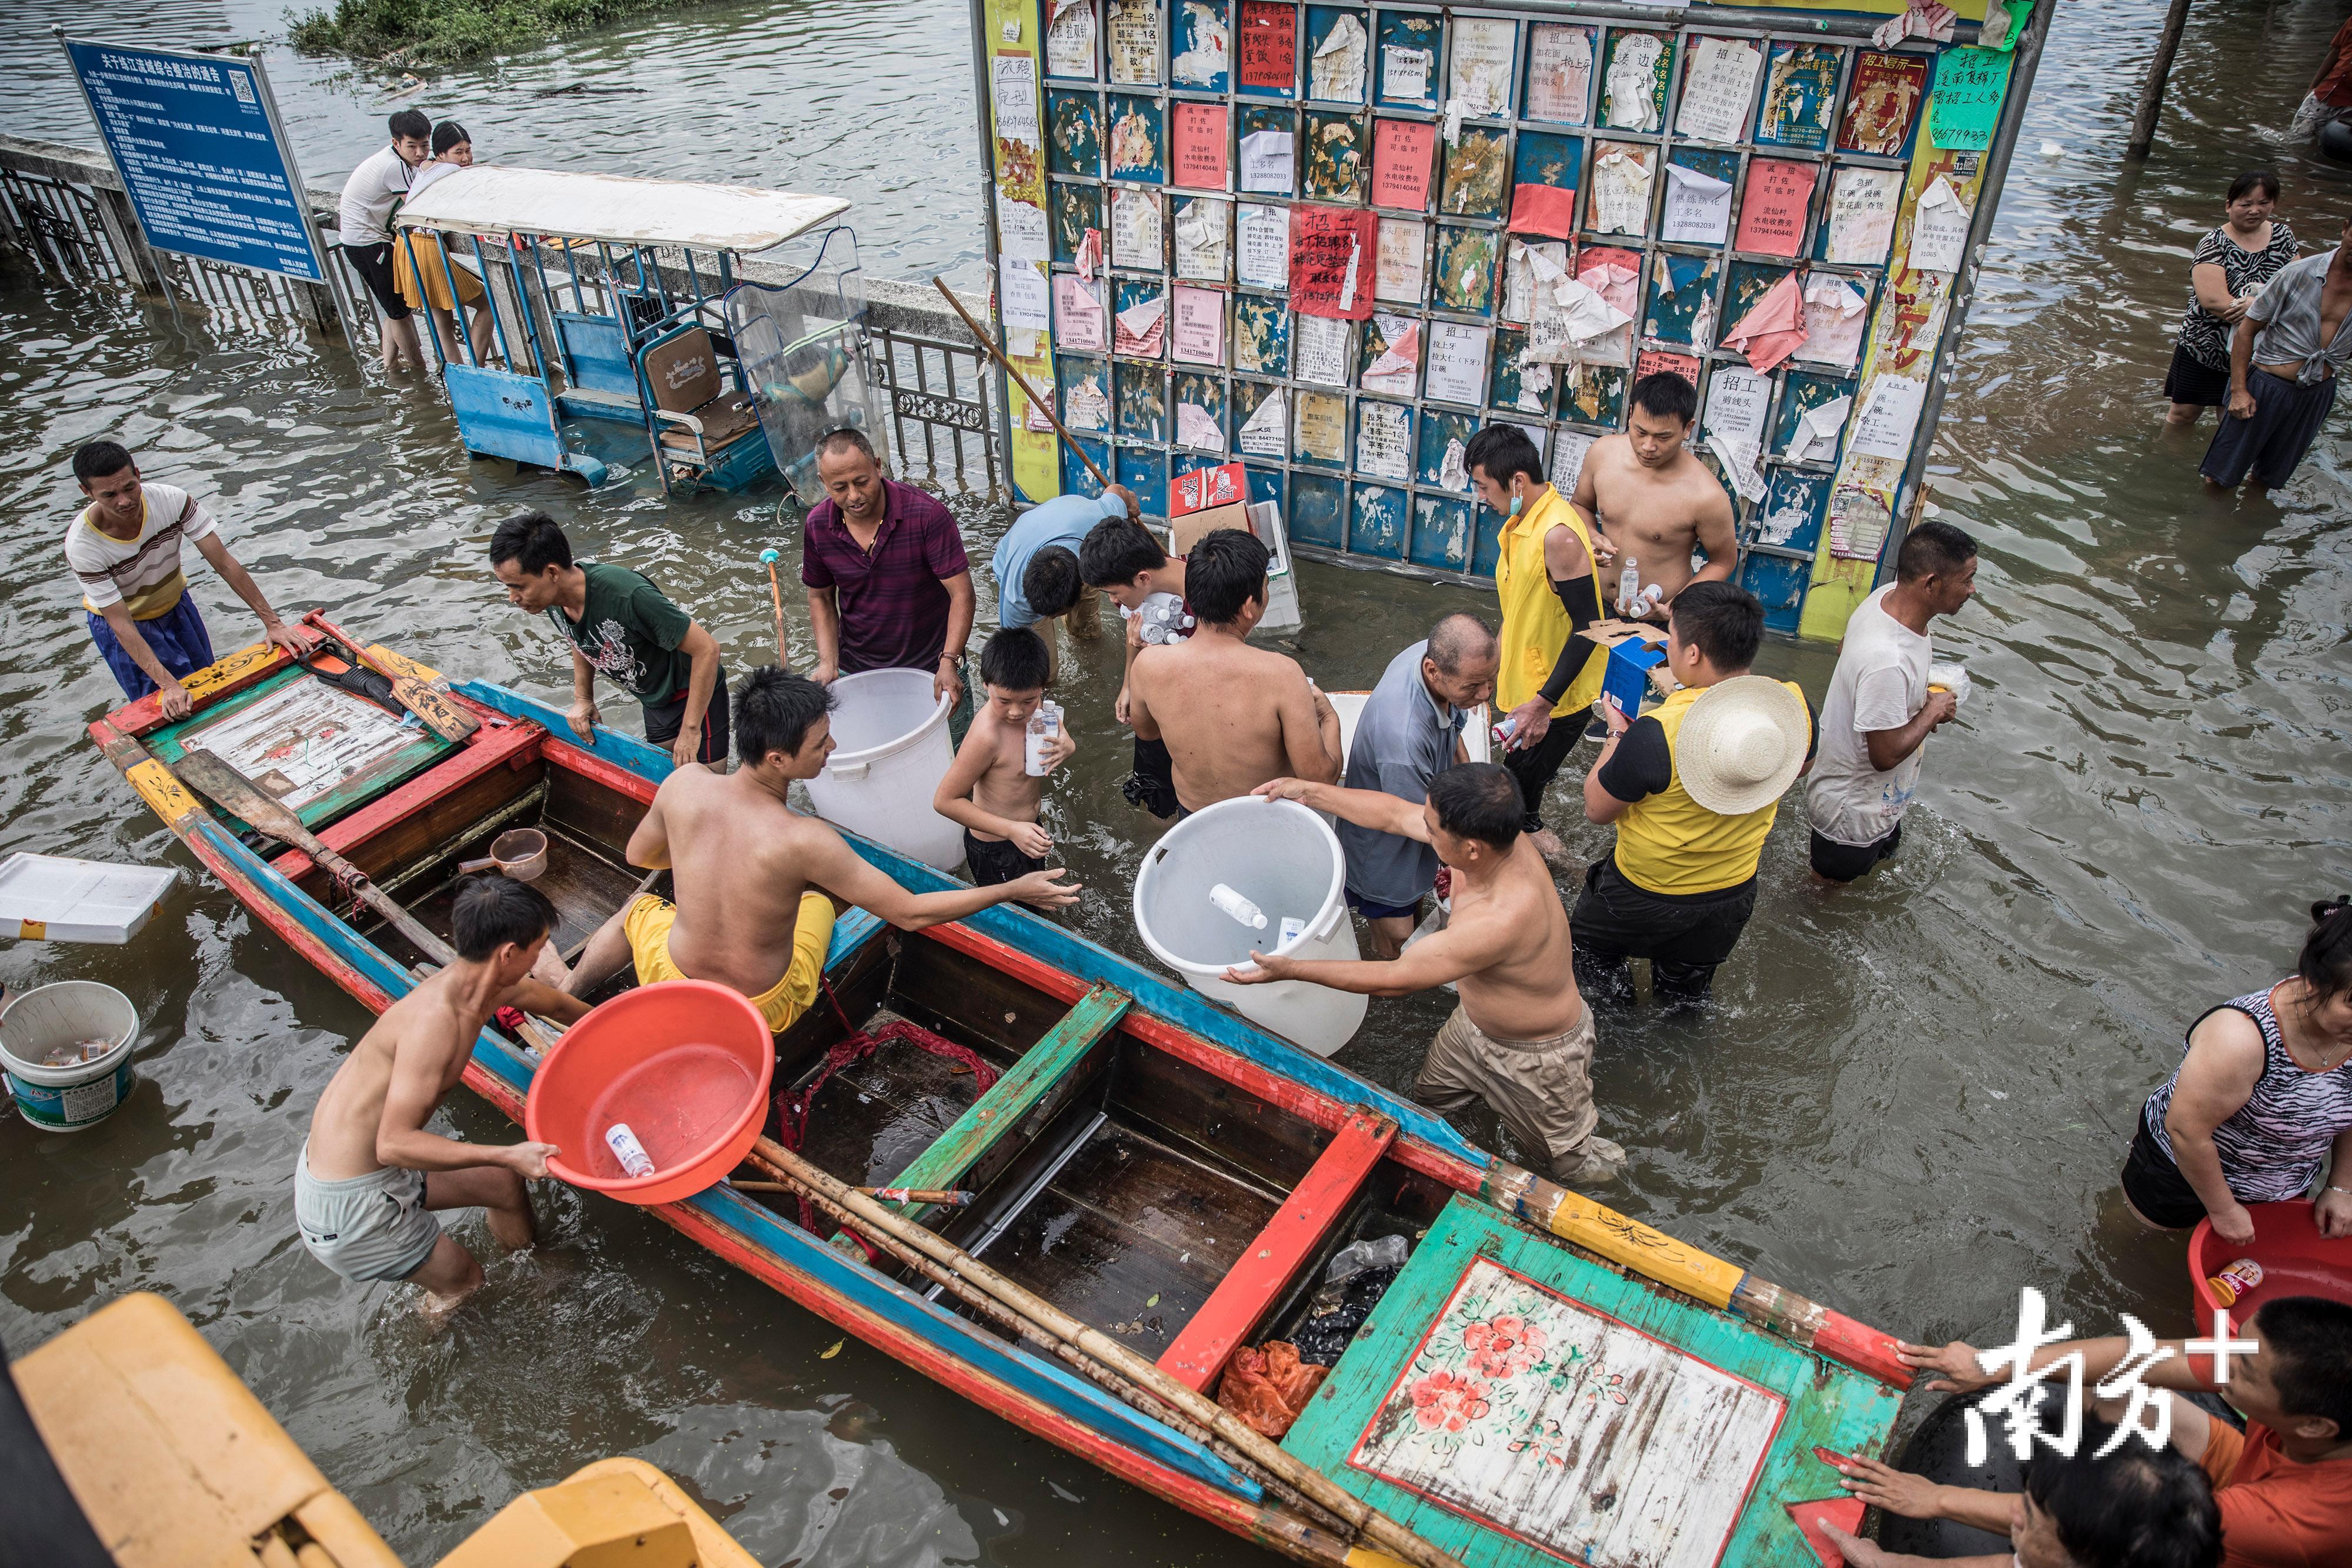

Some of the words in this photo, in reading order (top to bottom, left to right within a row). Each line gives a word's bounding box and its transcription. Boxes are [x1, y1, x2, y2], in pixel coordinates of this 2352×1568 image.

[1550, 33, 1576, 44] 招工
[1633, 38, 1652, 48] 急招
[1536, 48, 1560, 58] 加花面
[1716, 48, 1745, 63] 招工
[1959, 54, 1996, 69] 招工
[101, 54, 220, 83] 关于练江流域综合整治的通告
[997, 60, 1031, 79] 诚聘
[997, 89, 1032, 107] 定型
[1187, 107, 1210, 115] 诚招
[1188, 126, 1213, 135] 可临时
[1391, 123, 1416, 133] 诚招
[1779, 126, 1822, 135] 133-0270-6498
[1778, 132, 1821, 141] 189-9824-5553
[1776, 138, 1820, 146] 133-2271-8885
[1390, 143, 1418, 153] 可临时
[1185, 155, 1216, 163] 水电收费旁
[1183, 163, 1218, 172] 13794140448
[1392, 163, 1412, 172] 流仙村
[1767, 165, 1795, 175] 诚招
[1384, 173, 1419, 183] 水电收费旁
[1856, 178, 1872, 186] 急招
[1382, 182, 1420, 192] 13794140448
[1764, 186, 1795, 196] 可临时
[1675, 208, 1702, 218] 工多名
[1763, 207, 1787, 215] 流仙村
[1305, 212, 1358, 232] 招工
[1673, 221, 1715, 229] 13288082033
[1753, 216, 1793, 227] 水电收费旁
[1750, 227, 1793, 237] 13794140448
[1826, 279, 1841, 287] 招聘
[1813, 319, 1835, 330] 定型
[1446, 326, 1471, 337] 招工
[1432, 340, 1456, 350] 拉上牙
[1723, 375, 1758, 393] 招工
[1309, 396, 1331, 405] 招工
[1722, 395, 1752, 408] 剪线头
